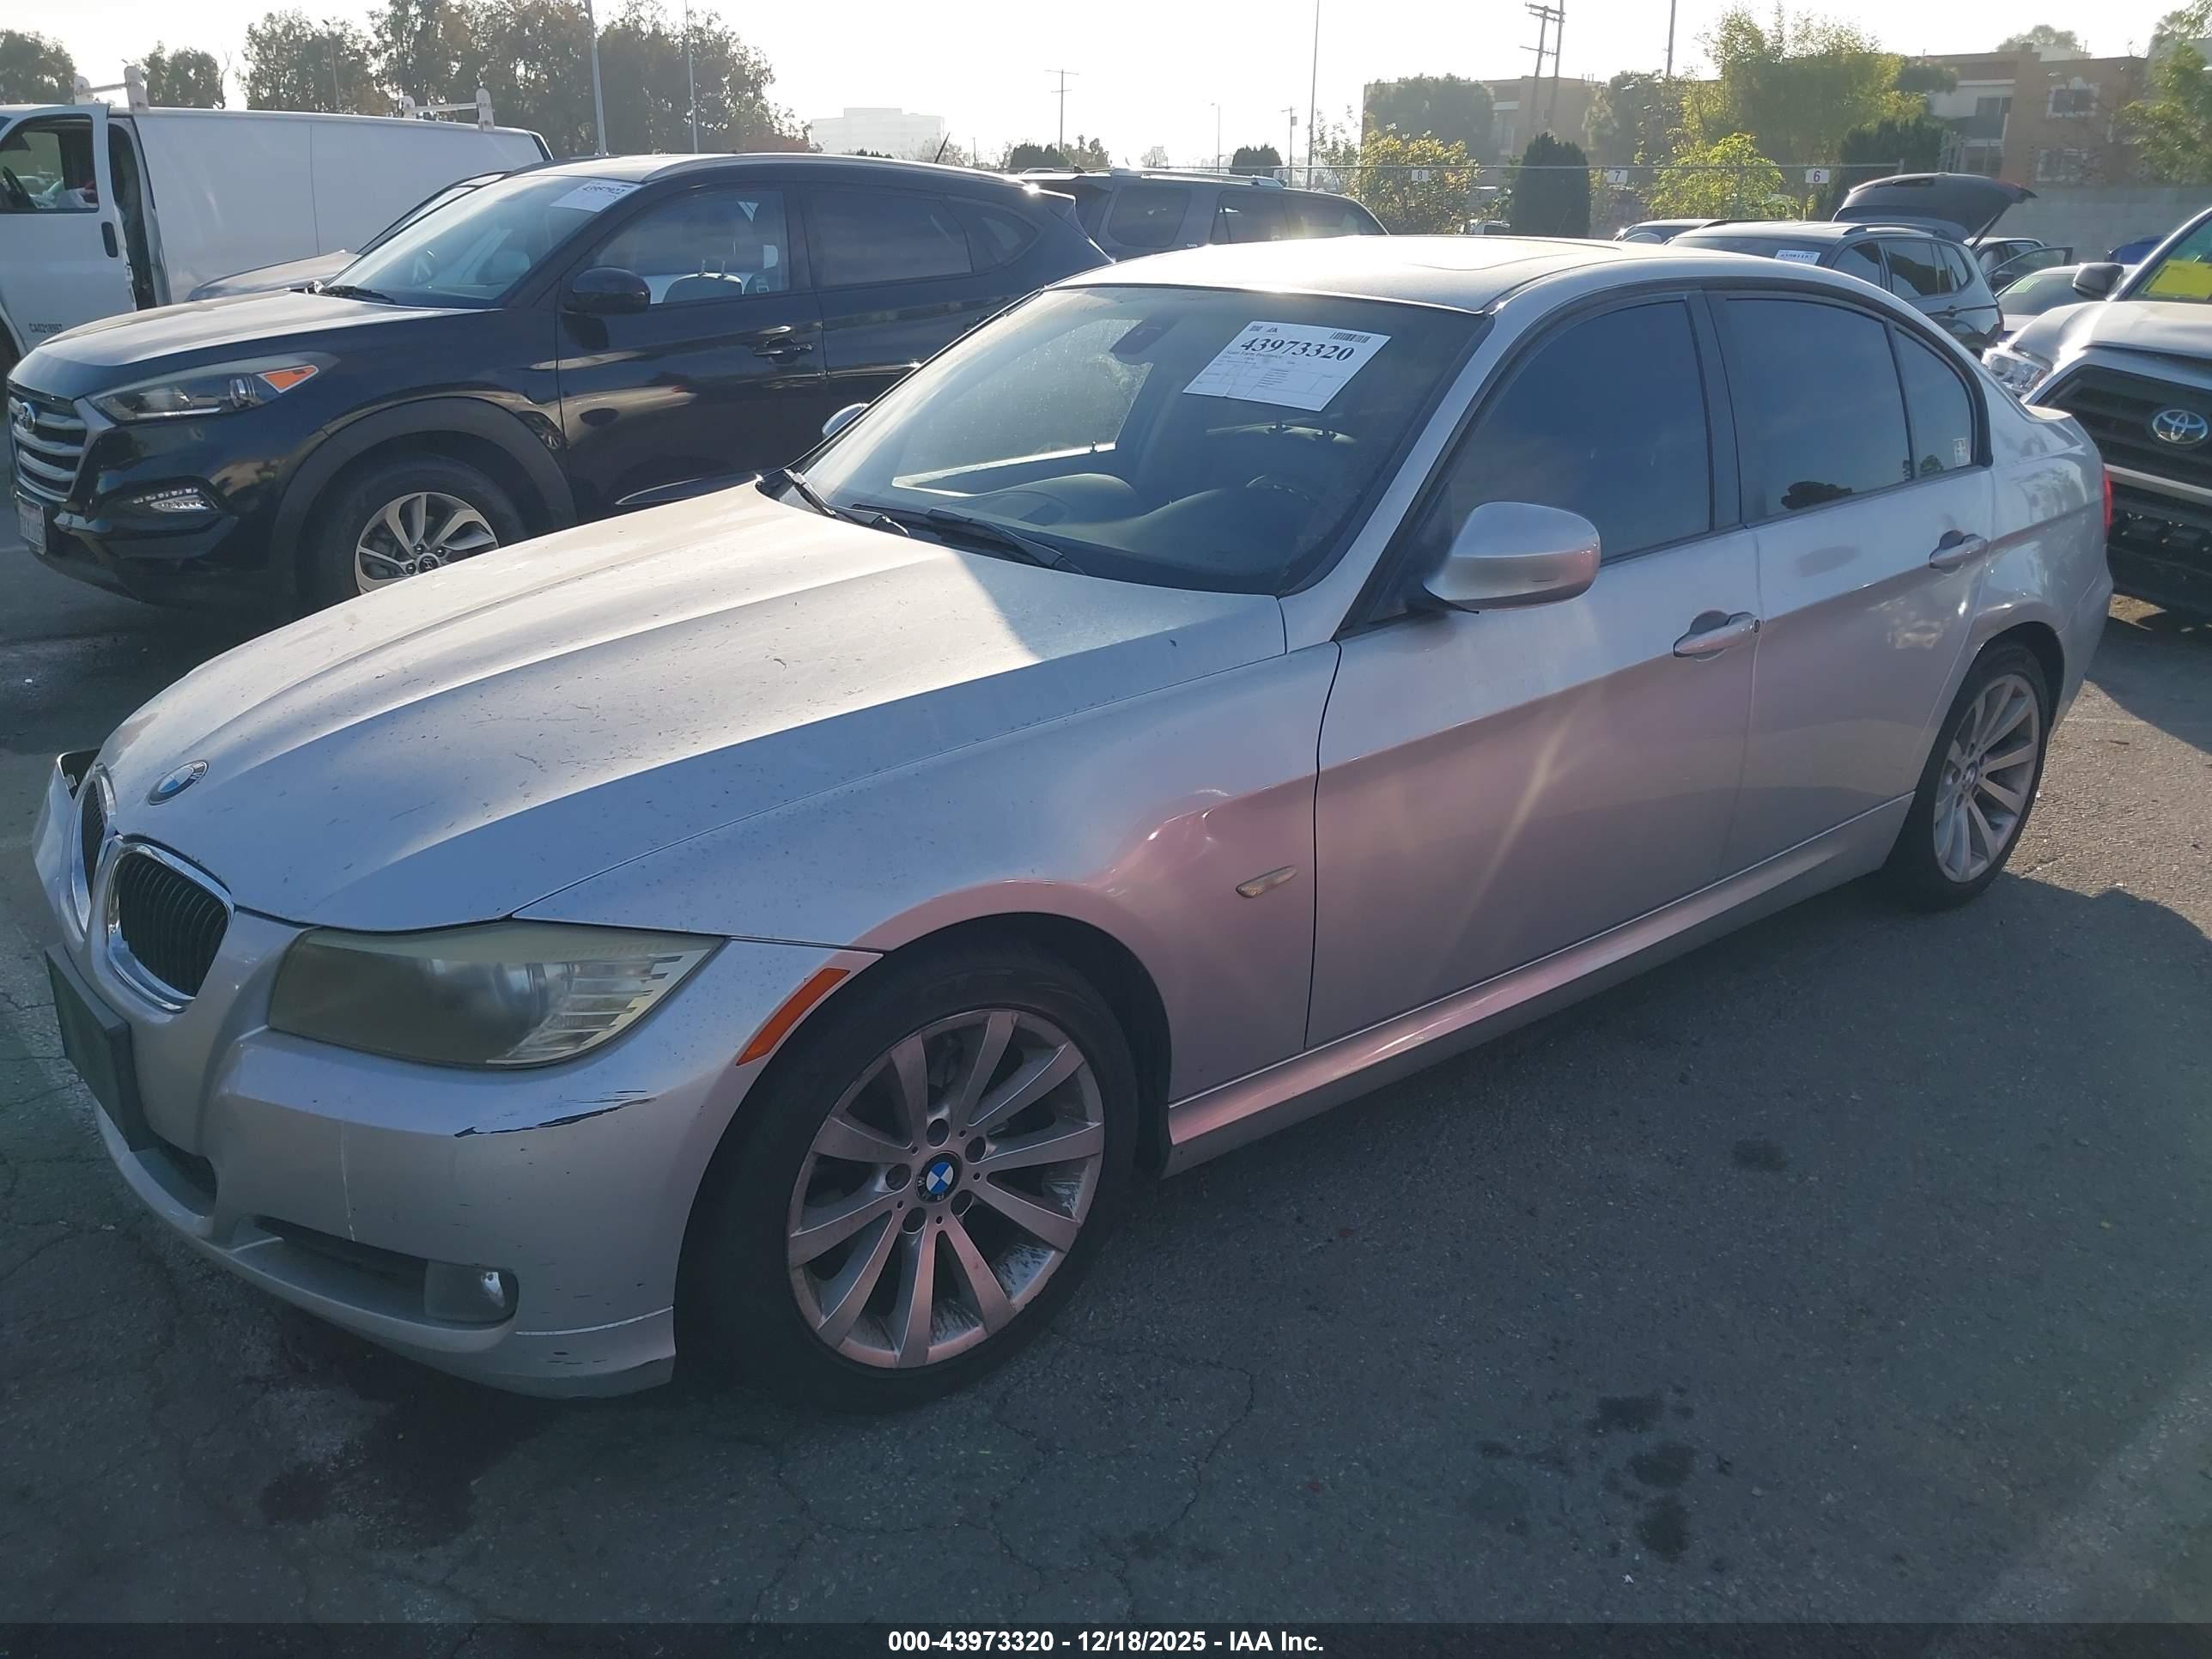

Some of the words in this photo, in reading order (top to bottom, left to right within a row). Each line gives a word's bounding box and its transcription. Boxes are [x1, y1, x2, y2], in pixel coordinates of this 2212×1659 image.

[1418, 170, 1423, 179] 8
[1615, 170, 1621, 181] 7
[1814, 170, 1820, 182] 6
[1240, 337, 1355, 362] 43973320
